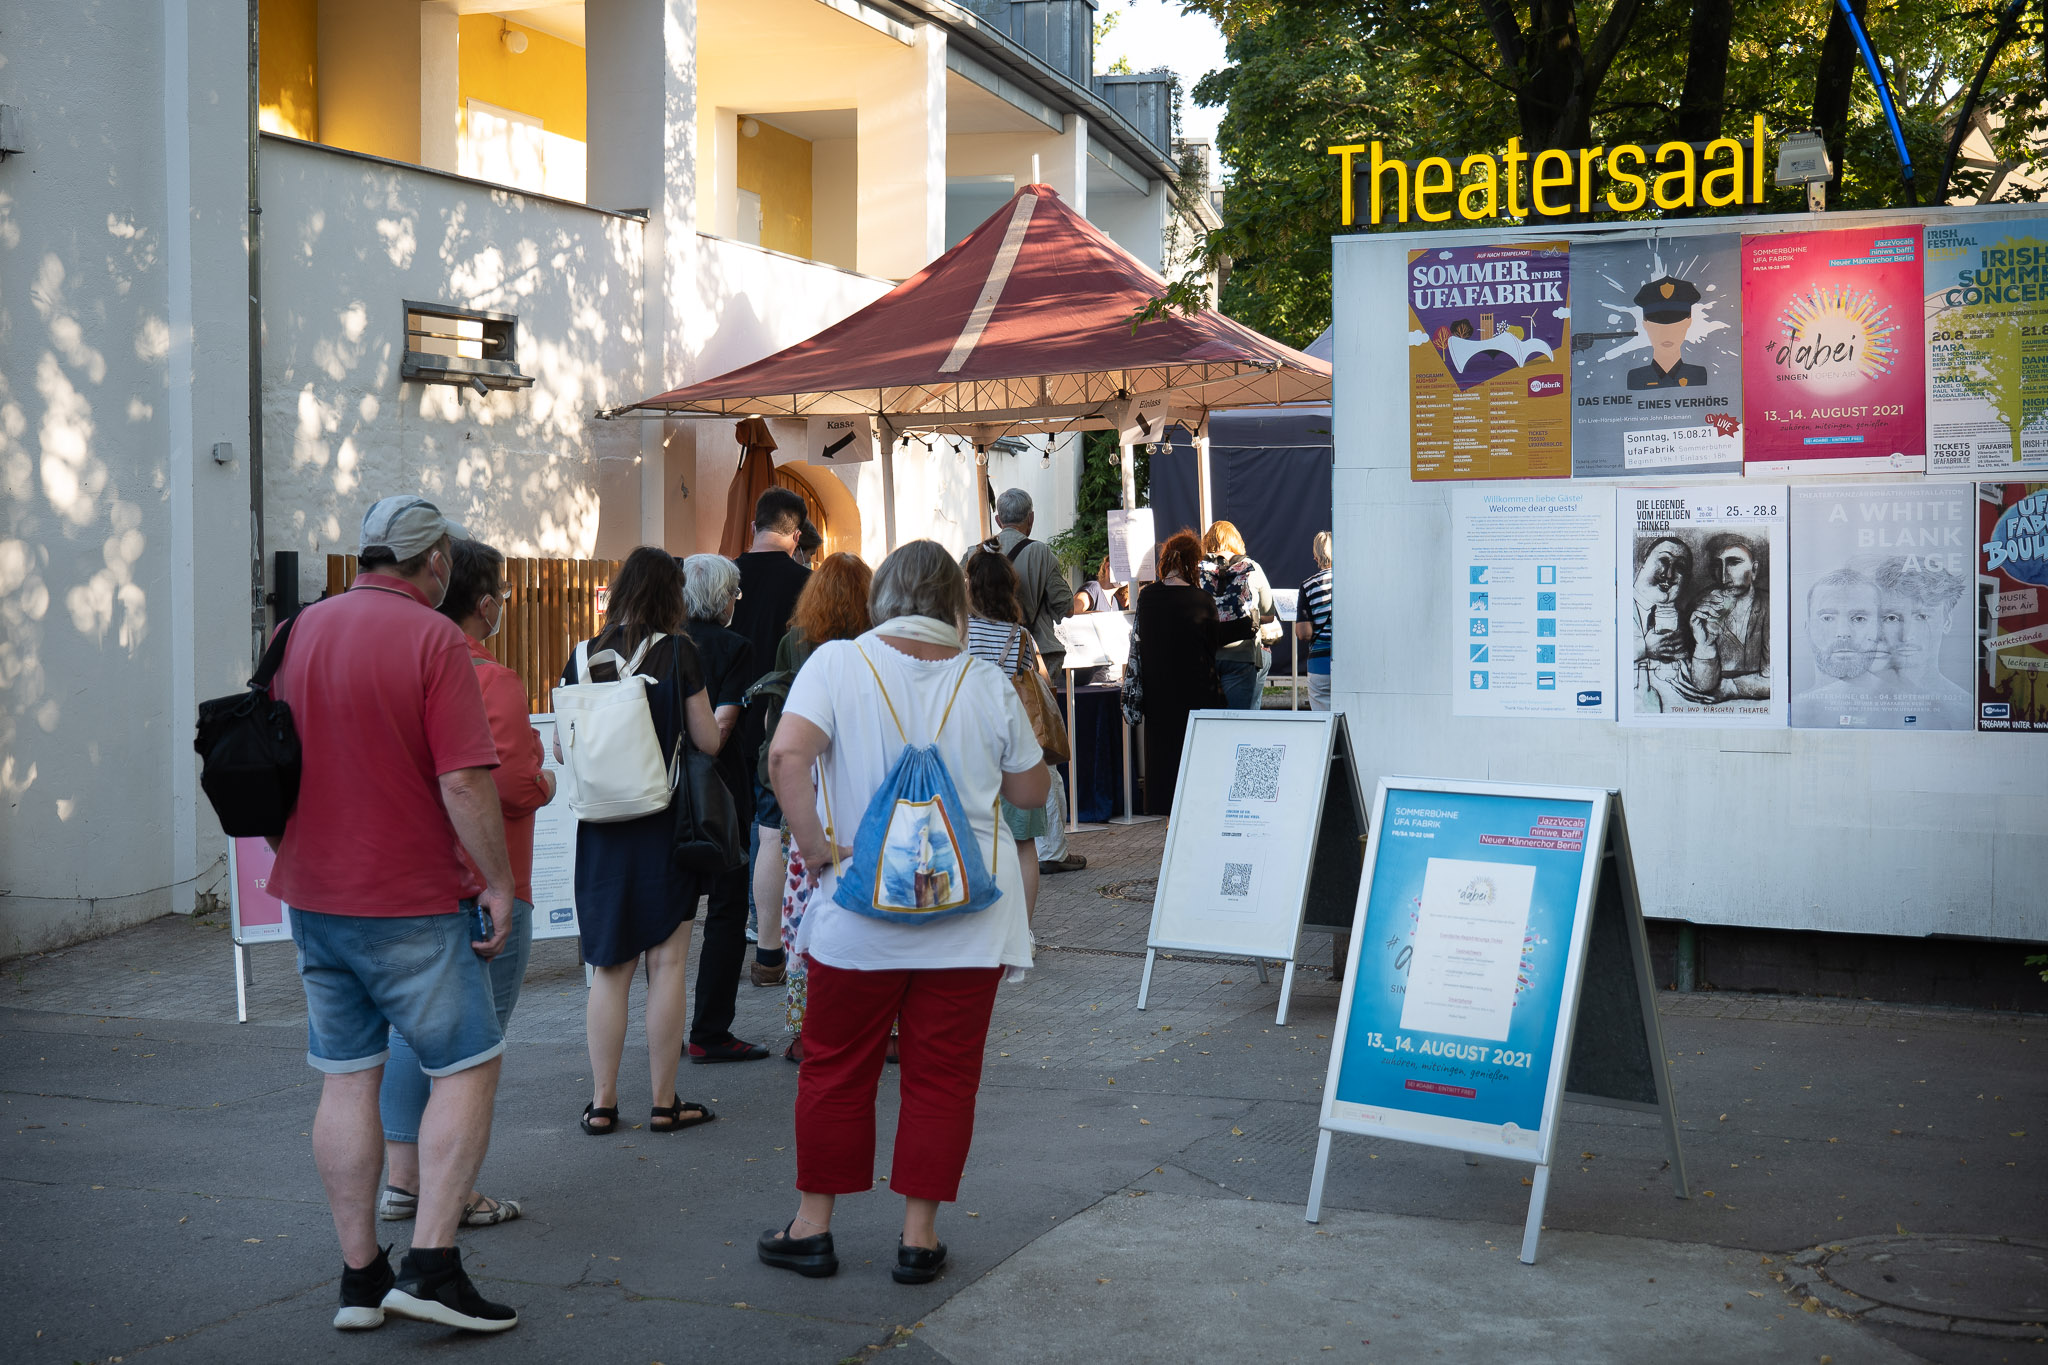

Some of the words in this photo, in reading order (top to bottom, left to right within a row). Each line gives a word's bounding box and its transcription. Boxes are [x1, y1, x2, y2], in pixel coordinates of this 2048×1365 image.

[1328, 115, 1766, 225] Theatersaal
[1928, 229, 1957, 239] IRISH
[1876, 238, 1914, 247] JazzVocals
[1928, 237, 1978, 248] FESTIVAL
[1753, 246, 1807, 256] SOMMERBÜHNE
[1928, 247, 1967, 257] BERLIN
[1852, 256, 1893, 265] Männerchor
[1893, 254, 1914, 262] Berlin
[1413, 261, 1529, 287] SOMMER
[1543, 271, 1561, 279] DER
[1413, 281, 1563, 309] UFAFABRIK
[1932, 330, 1967, 341] 20.8.
[1932, 344, 1965, 352] MARA
[1138, 397, 1161, 409] Einlass
[1578, 397, 1599, 406] DAS
[1603, 395, 1632, 405] ENDE
[1638, 400, 1671, 409] EINES
[1675, 396, 1728, 408] VERHÖRS
[1811, 406, 1868, 419] AUGUST
[1873, 405, 1904, 416] 2021
[827, 420, 855, 430] Kasse
[1717, 418, 1733, 432] LIVE
[1856, 419, 1888, 430] genießen
[1673, 429, 1712, 439] 15.08.21
[1628, 446, 1675, 456] ufaFabrik
[1679, 443, 1732, 452] Sommerbühne
[1660, 455, 1672, 463] 19h
[1483, 495, 1533, 503] Willkommen
[1558, 494, 1583, 502] Gäste!
[1637, 500, 1649, 509] DIE
[1651, 499, 1685, 509] LEGENDE
[1489, 504, 1526, 512] Welcome
[1528, 504, 1546, 512] dear
[1548, 504, 1577, 513] guests!
[1726, 506, 1742, 516] 25.
[1754, 505, 1777, 516] 28.8
[1828, 503, 1848, 522] A
[1860, 501, 1963, 521] WHITE
[1637, 510, 1653, 520] VOM
[1656, 510, 1690, 520] HEILIGEN
[1637, 521, 1670, 530] TRINKER
[1858, 527, 1963, 547] BLANK
[2000, 594, 2027, 602] MUSIK
[1995, 605, 2016, 614] Open
[1990, 631, 2043, 648] Marktstände
[2007, 659, 2040, 668] leckeres
[1980, 720, 2010, 729] PROGRAMM
[1395, 807, 1459, 819] SOMMERBÜHNE
[1394, 818, 1410, 827] UFA
[1412, 820, 1441, 828] FABRIK
[1539, 817, 1584, 828] JazzVocals
[1531, 828, 1559, 838] niniwe,
[1481, 836, 1506, 845] Neuer
[1507, 837, 1554, 849] Männerchor
[1556, 841, 1581, 850] Berlin
[1419, 1039, 1490, 1063] AUGUST
[1492, 1049, 1532, 1068] 2021
[1381, 1057, 1417, 1070] zuhören,
[1422, 1062, 1466, 1077] mitsingen,
[1470, 1068, 1510, 1083] genießen
